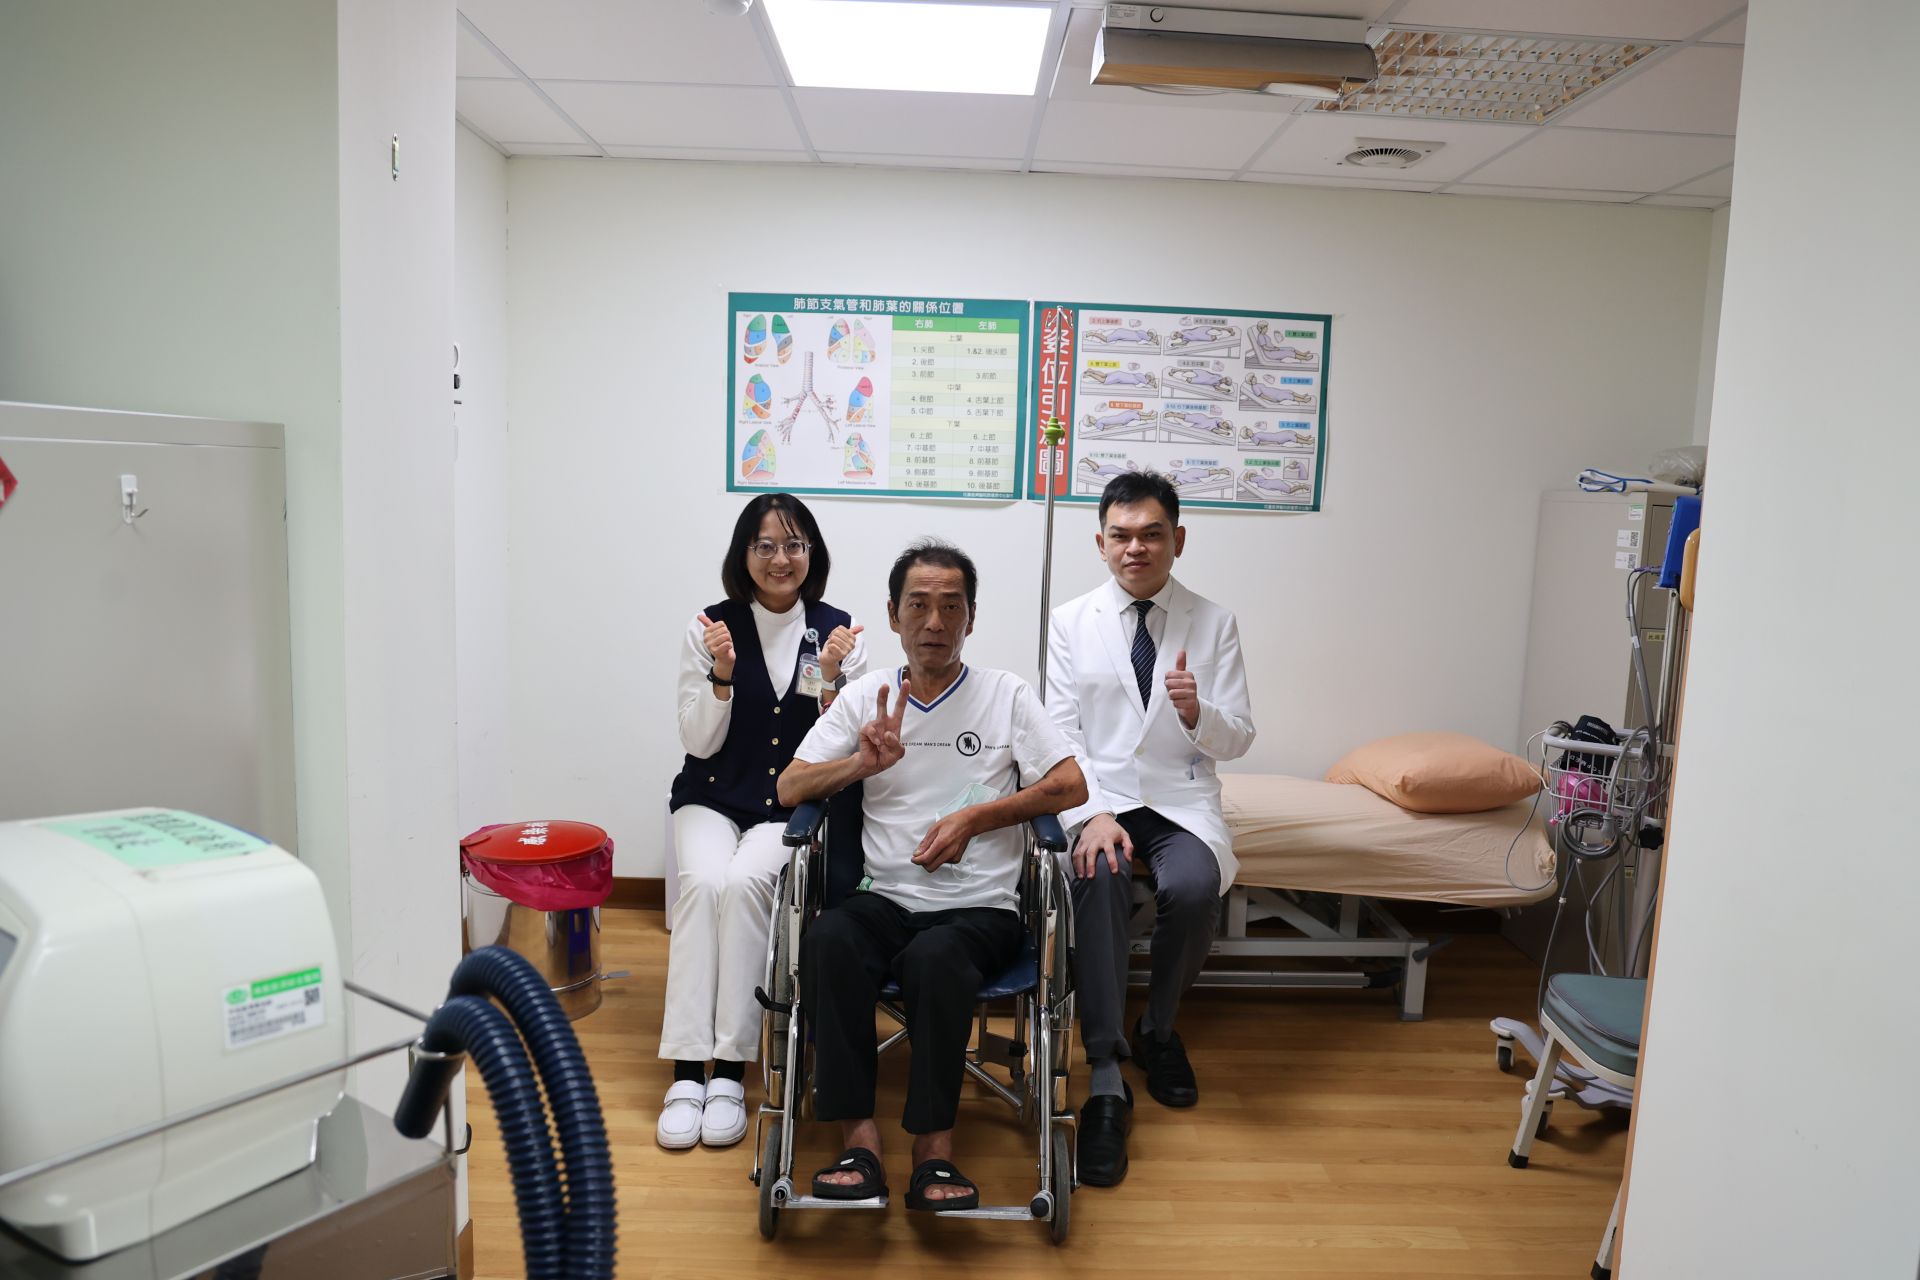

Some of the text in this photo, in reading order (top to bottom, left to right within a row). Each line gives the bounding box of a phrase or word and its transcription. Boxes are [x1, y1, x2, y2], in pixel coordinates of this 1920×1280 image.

[794, 298, 964, 314] 肺節支氣管和肺葉的關係位置
[915, 320, 934, 329] 右肺
[978, 321, 997, 330] 左肺
